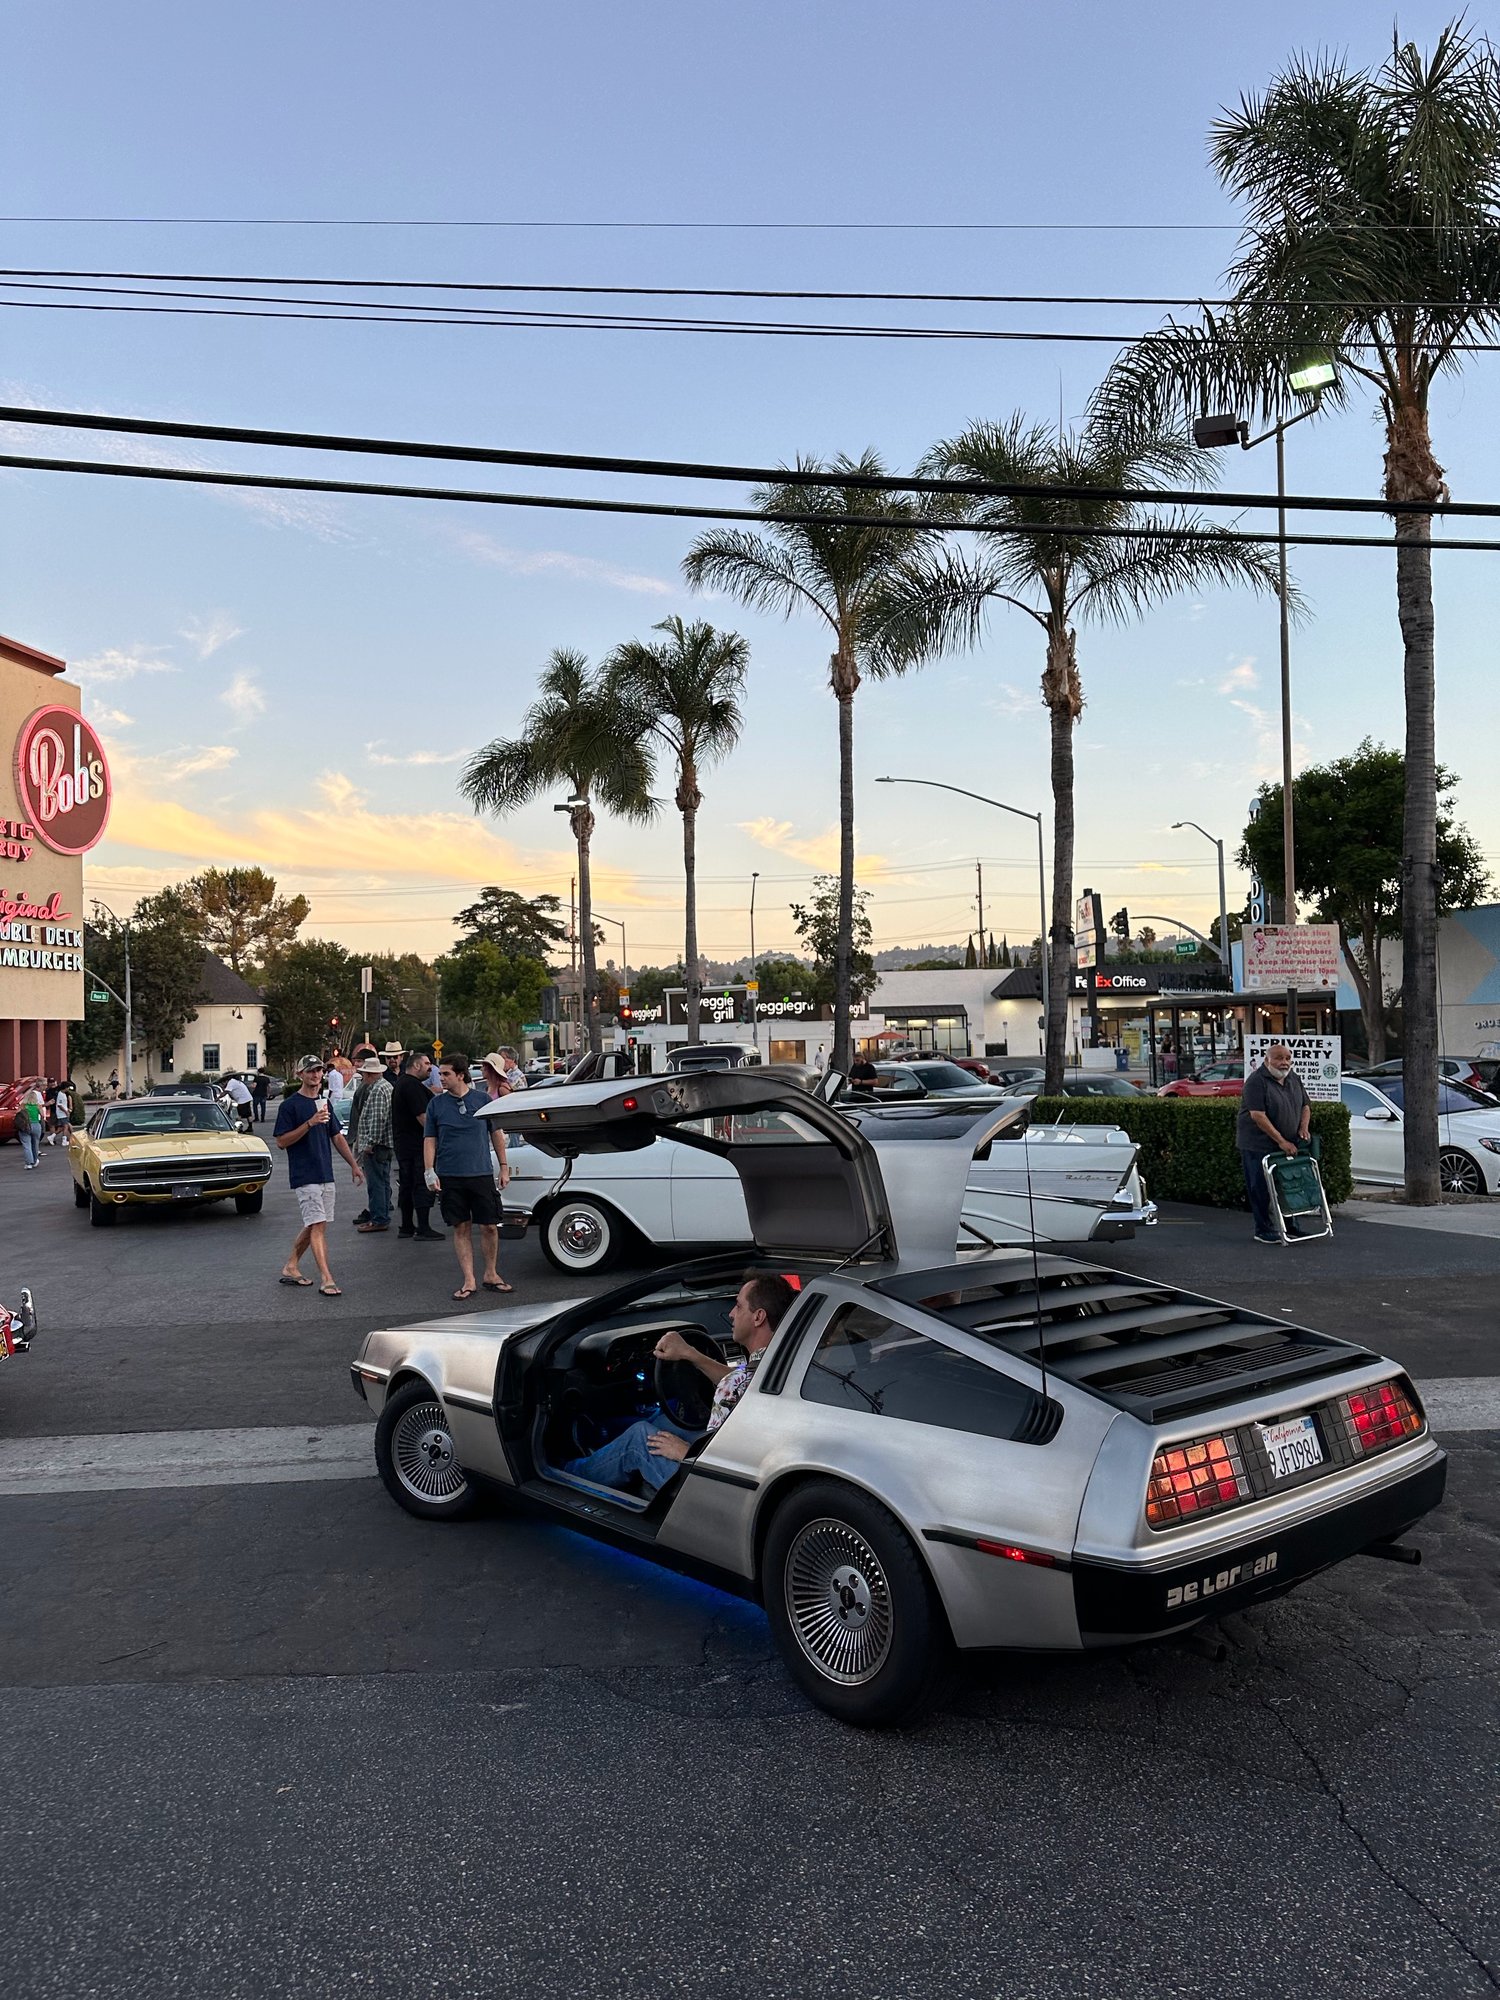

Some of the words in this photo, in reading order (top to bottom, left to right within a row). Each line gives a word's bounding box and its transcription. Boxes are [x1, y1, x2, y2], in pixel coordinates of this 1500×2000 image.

[30, 724, 104, 821] Bob's
[46, 926, 84, 948] DECK
[0, 947, 84, 972] MBURGER
[1292, 947, 1332, 956] neighbors
[1258, 958, 1278, 966] keep
[1075, 973, 1112, 988] FeEx
[1112, 975, 1147, 987] Office
[713, 1006, 734, 1023] grill
[1260, 1039, 1324, 1049] PRIVATE
[1270, 1425, 1307, 1444] California
